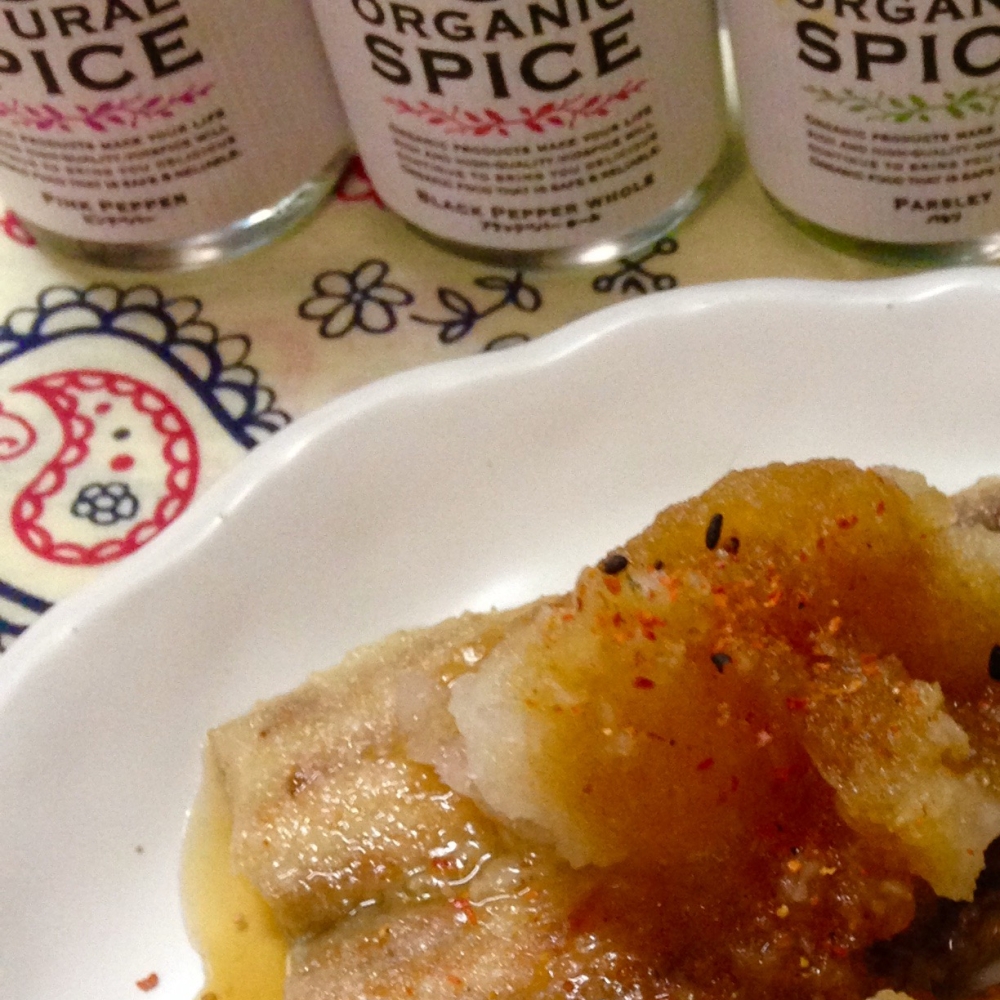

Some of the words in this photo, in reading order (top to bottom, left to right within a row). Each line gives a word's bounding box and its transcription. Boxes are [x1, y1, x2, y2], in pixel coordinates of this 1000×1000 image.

[364, 9, 642, 99] SPICE
[490, 203, 578, 219] PEPPER
[893, 191, 992, 212] PARSLEY
